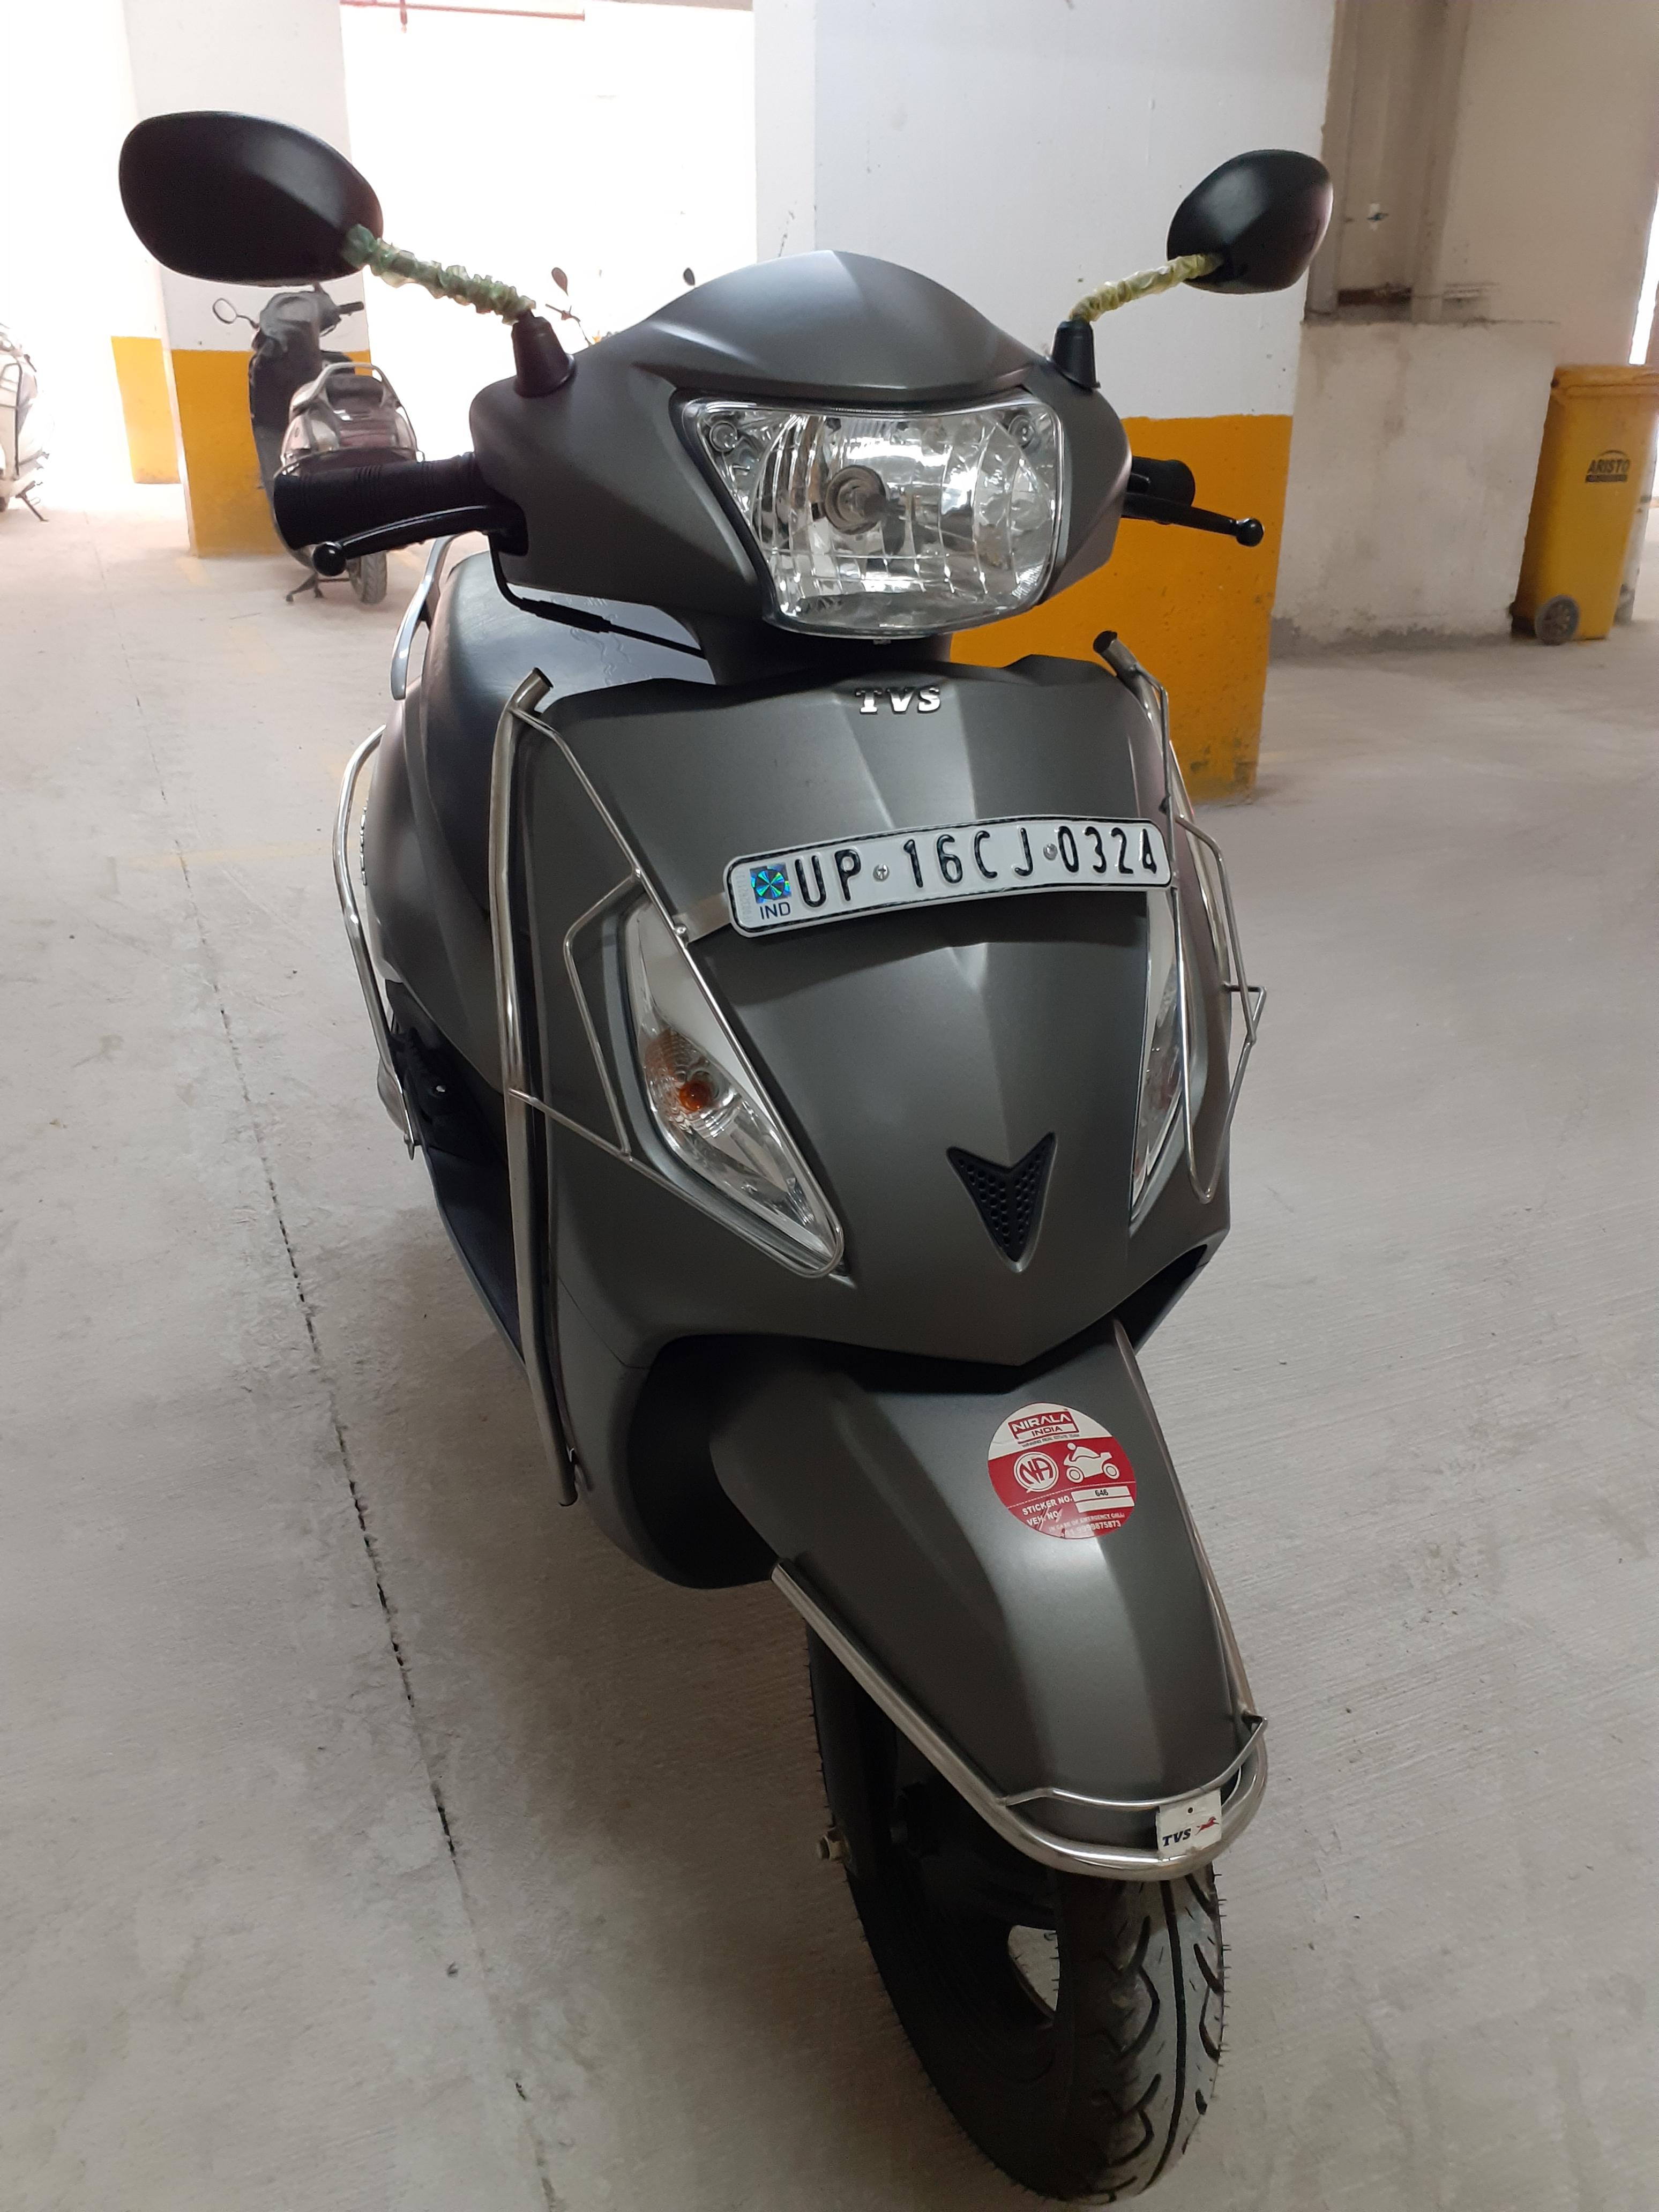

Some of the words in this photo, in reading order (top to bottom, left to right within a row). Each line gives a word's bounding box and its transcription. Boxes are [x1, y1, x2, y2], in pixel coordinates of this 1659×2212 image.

[1587, 459, 1630, 474] ARISTO
[855, 686, 941, 714] TVS
[795, 848, 861, 908] UP
[1058, 826, 1156, 875] 0324
[760, 901, 790, 920] IND
[1011, 1413, 1071, 1432] NIRALA
[1032, 1426, 1063, 1437] INDIA
[1022, 1499, 1057, 1515] STICKER
[1058, 1495, 1072, 1504] NO.
[1162, 1828, 1191, 1847] TVS
